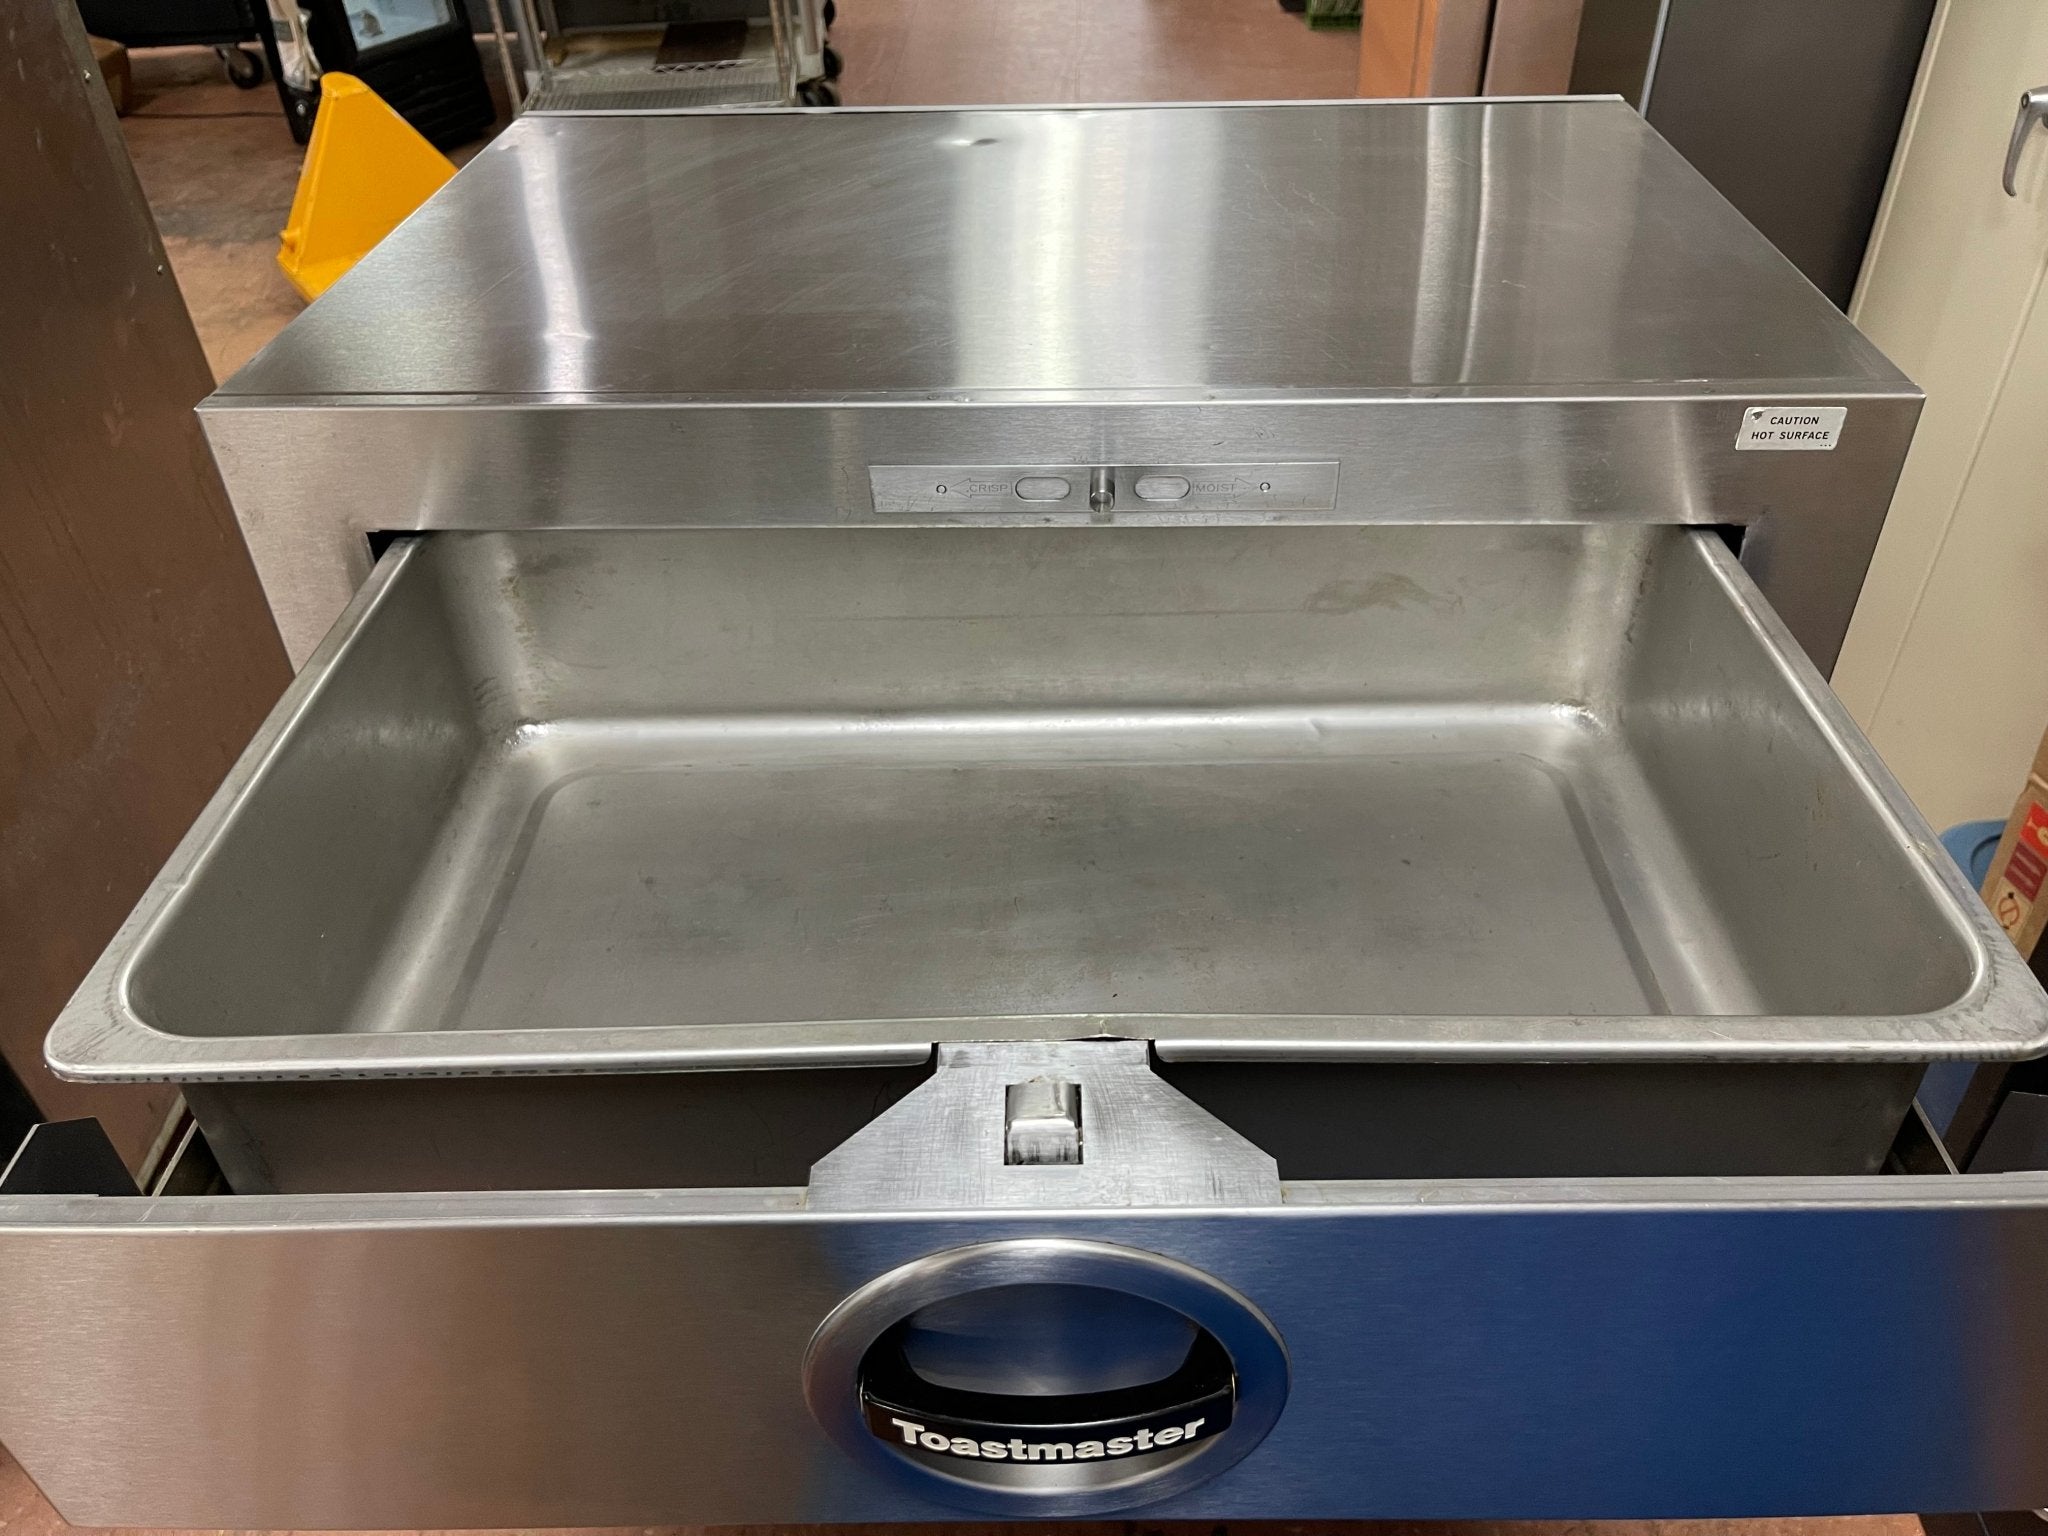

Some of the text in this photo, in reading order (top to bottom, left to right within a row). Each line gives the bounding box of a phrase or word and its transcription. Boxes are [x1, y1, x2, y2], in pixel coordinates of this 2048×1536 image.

[1770, 416, 1820, 425] CAUTION
[1750, 431, 1830, 440] HOT SURFACE
[968, 483, 1009, 493] CRISP
[1195, 482, 1236, 493] MOIST
[891, 1417, 1206, 1460] Toastmaster
